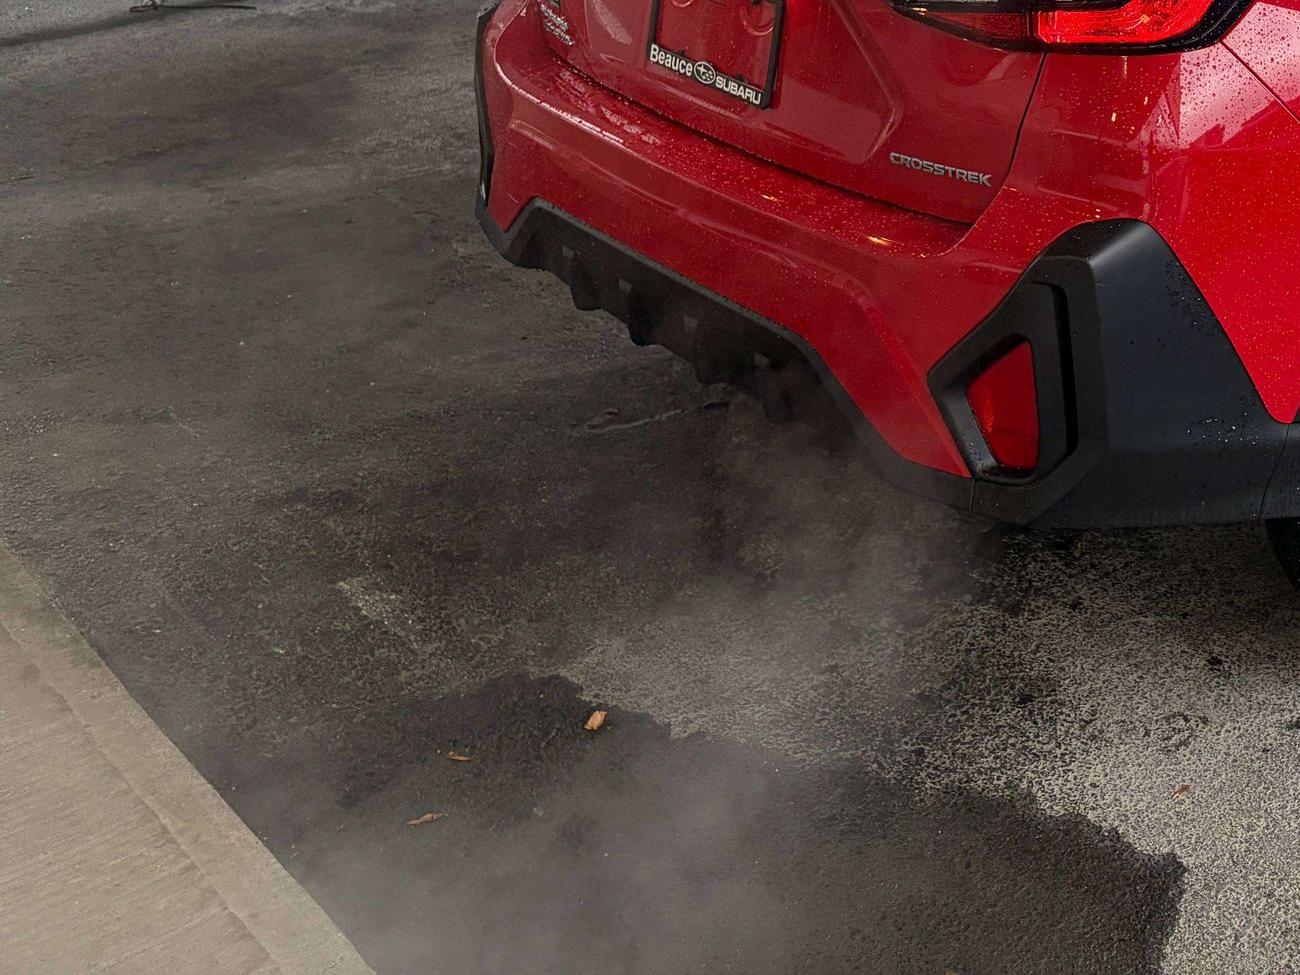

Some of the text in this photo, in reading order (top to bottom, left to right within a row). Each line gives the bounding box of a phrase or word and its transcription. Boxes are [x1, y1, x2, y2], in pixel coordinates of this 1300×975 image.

[649, 43, 762, 105] Beauce SUBARU
[889, 152, 992, 187] CROSSTREK
